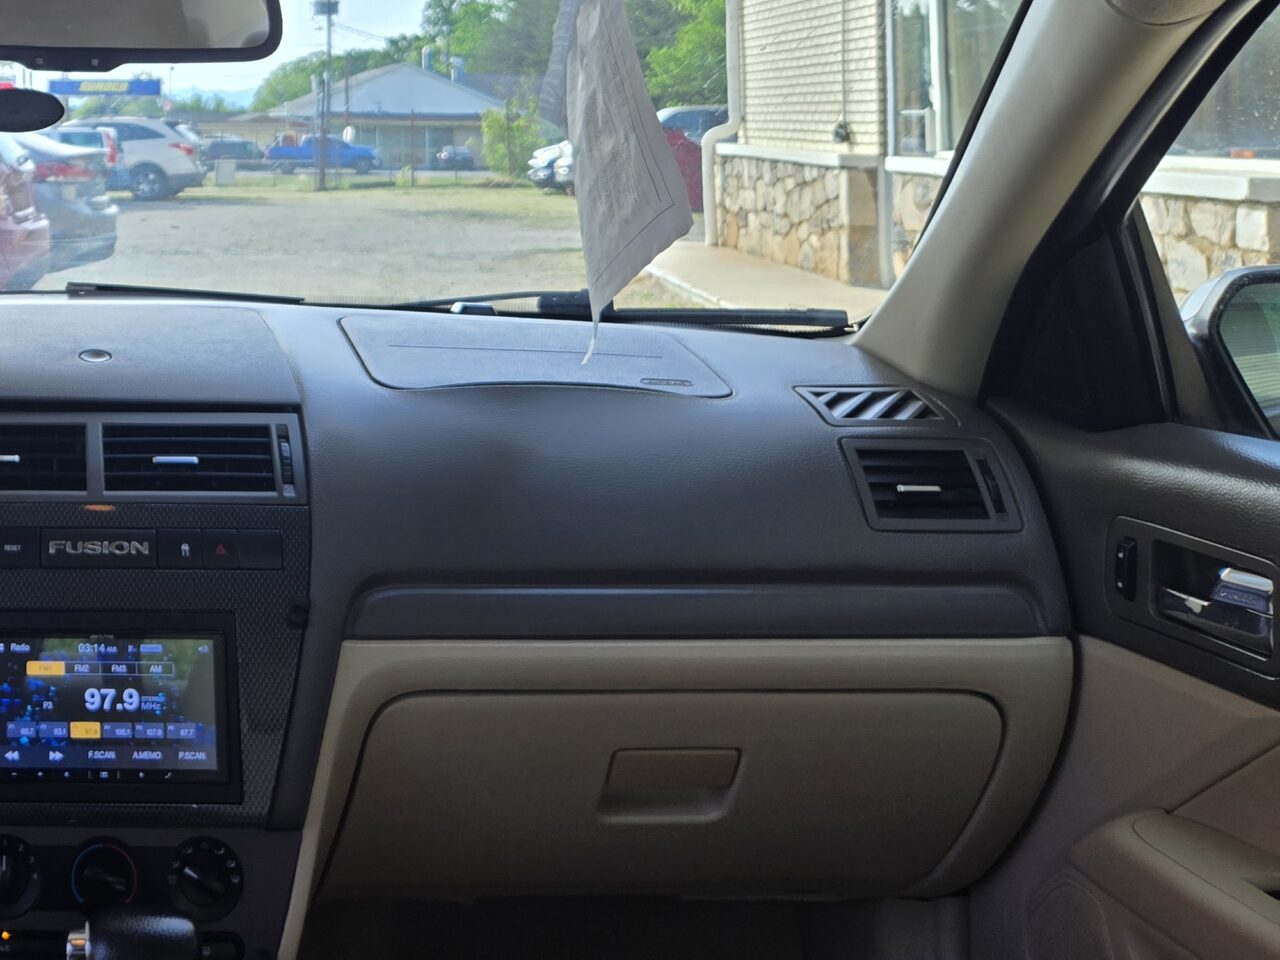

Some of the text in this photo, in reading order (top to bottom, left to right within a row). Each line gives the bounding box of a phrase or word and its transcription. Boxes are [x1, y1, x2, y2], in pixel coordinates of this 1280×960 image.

[48, 540, 150, 555] FUSION
[10, 643, 30, 651] Radio
[78, 643, 105, 652] 03:14
[74, 664, 90, 672] FM2
[111, 664, 127, 672] FM3
[149, 664, 162, 672] AM
[84, 687, 140, 711] 97.9
[141, 702, 161, 710] MHz
